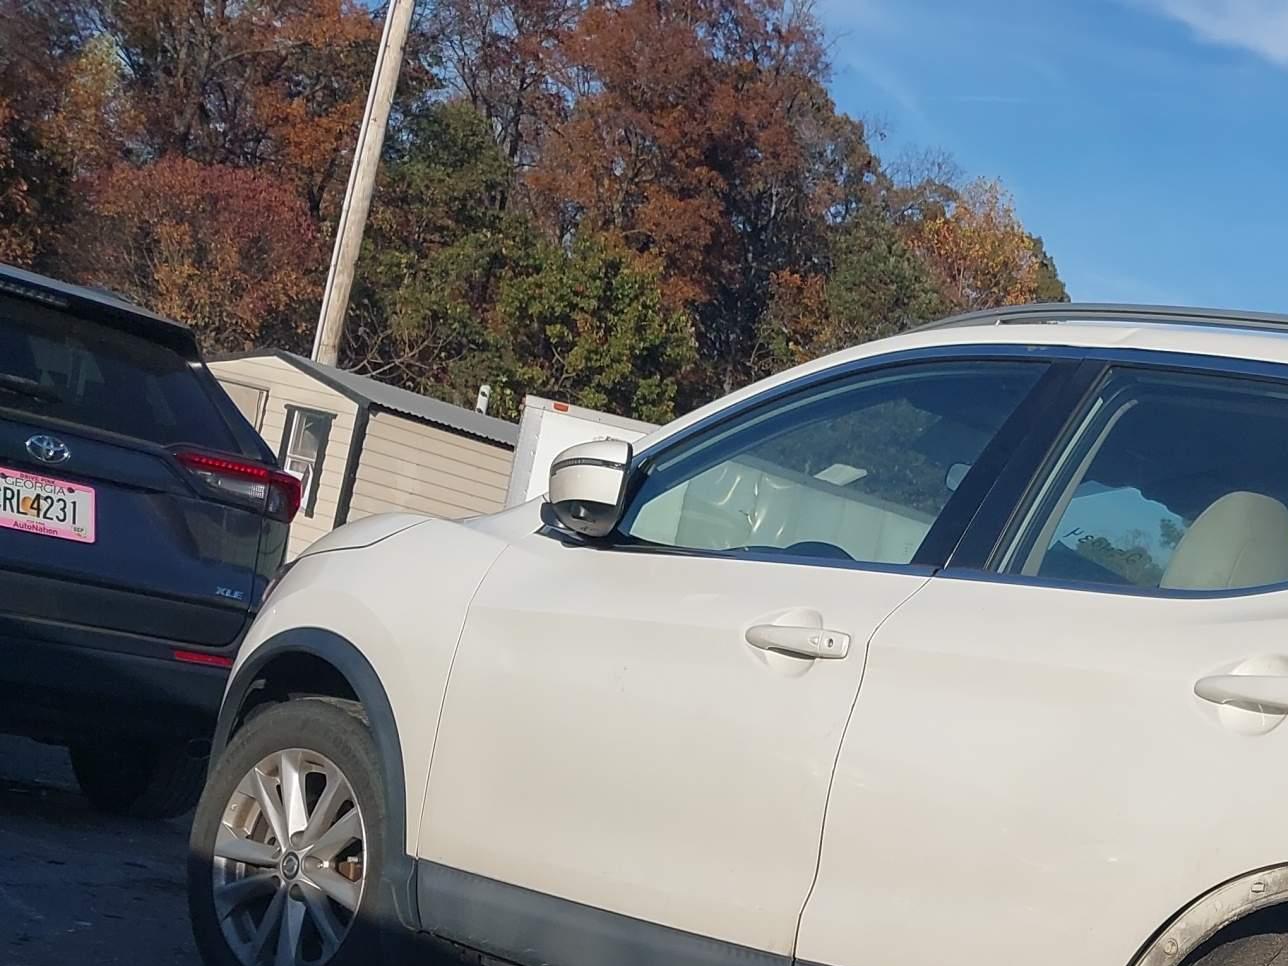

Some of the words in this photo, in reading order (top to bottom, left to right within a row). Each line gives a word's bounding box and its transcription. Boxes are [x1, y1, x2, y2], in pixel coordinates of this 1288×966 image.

[5, 477, 65, 496] GEORGIA
[0, 485, 77, 525] RL4231
[13, 521, 58, 535] AutoNation
